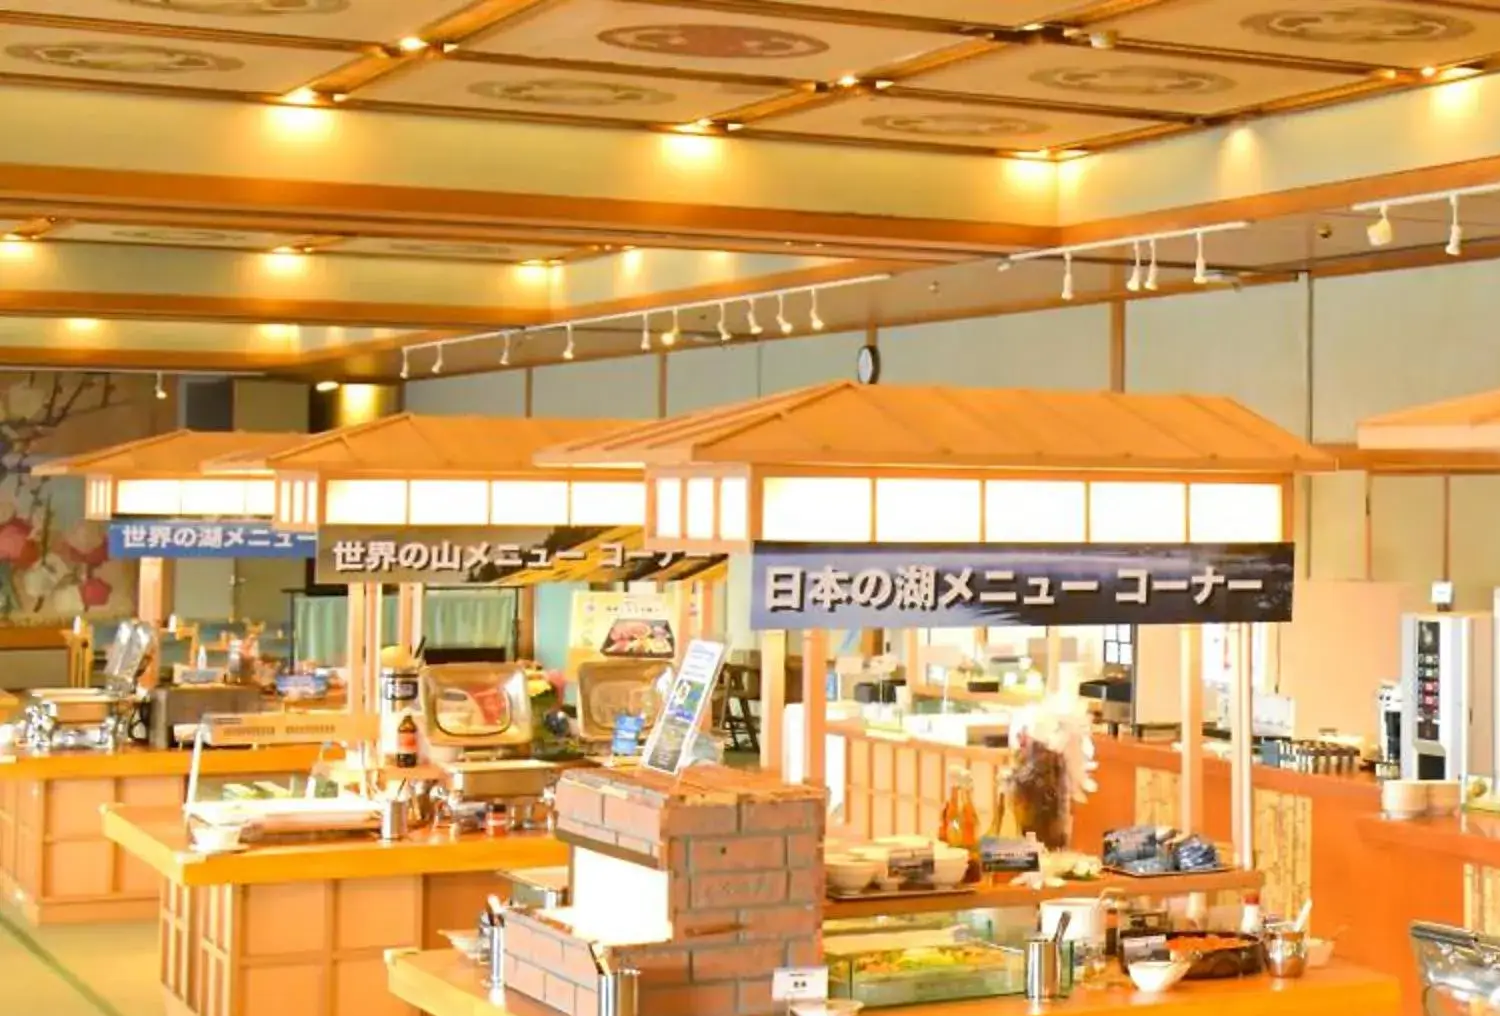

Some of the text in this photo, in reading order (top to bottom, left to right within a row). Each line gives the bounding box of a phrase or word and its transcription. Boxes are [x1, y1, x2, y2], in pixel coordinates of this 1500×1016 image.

[122, 525, 317, 549] 世界の湖メニュー
[333, 540, 586, 571] 世界の山メニュー
[764, 565, 1263, 611] 日本の湖メニュー コーナー
